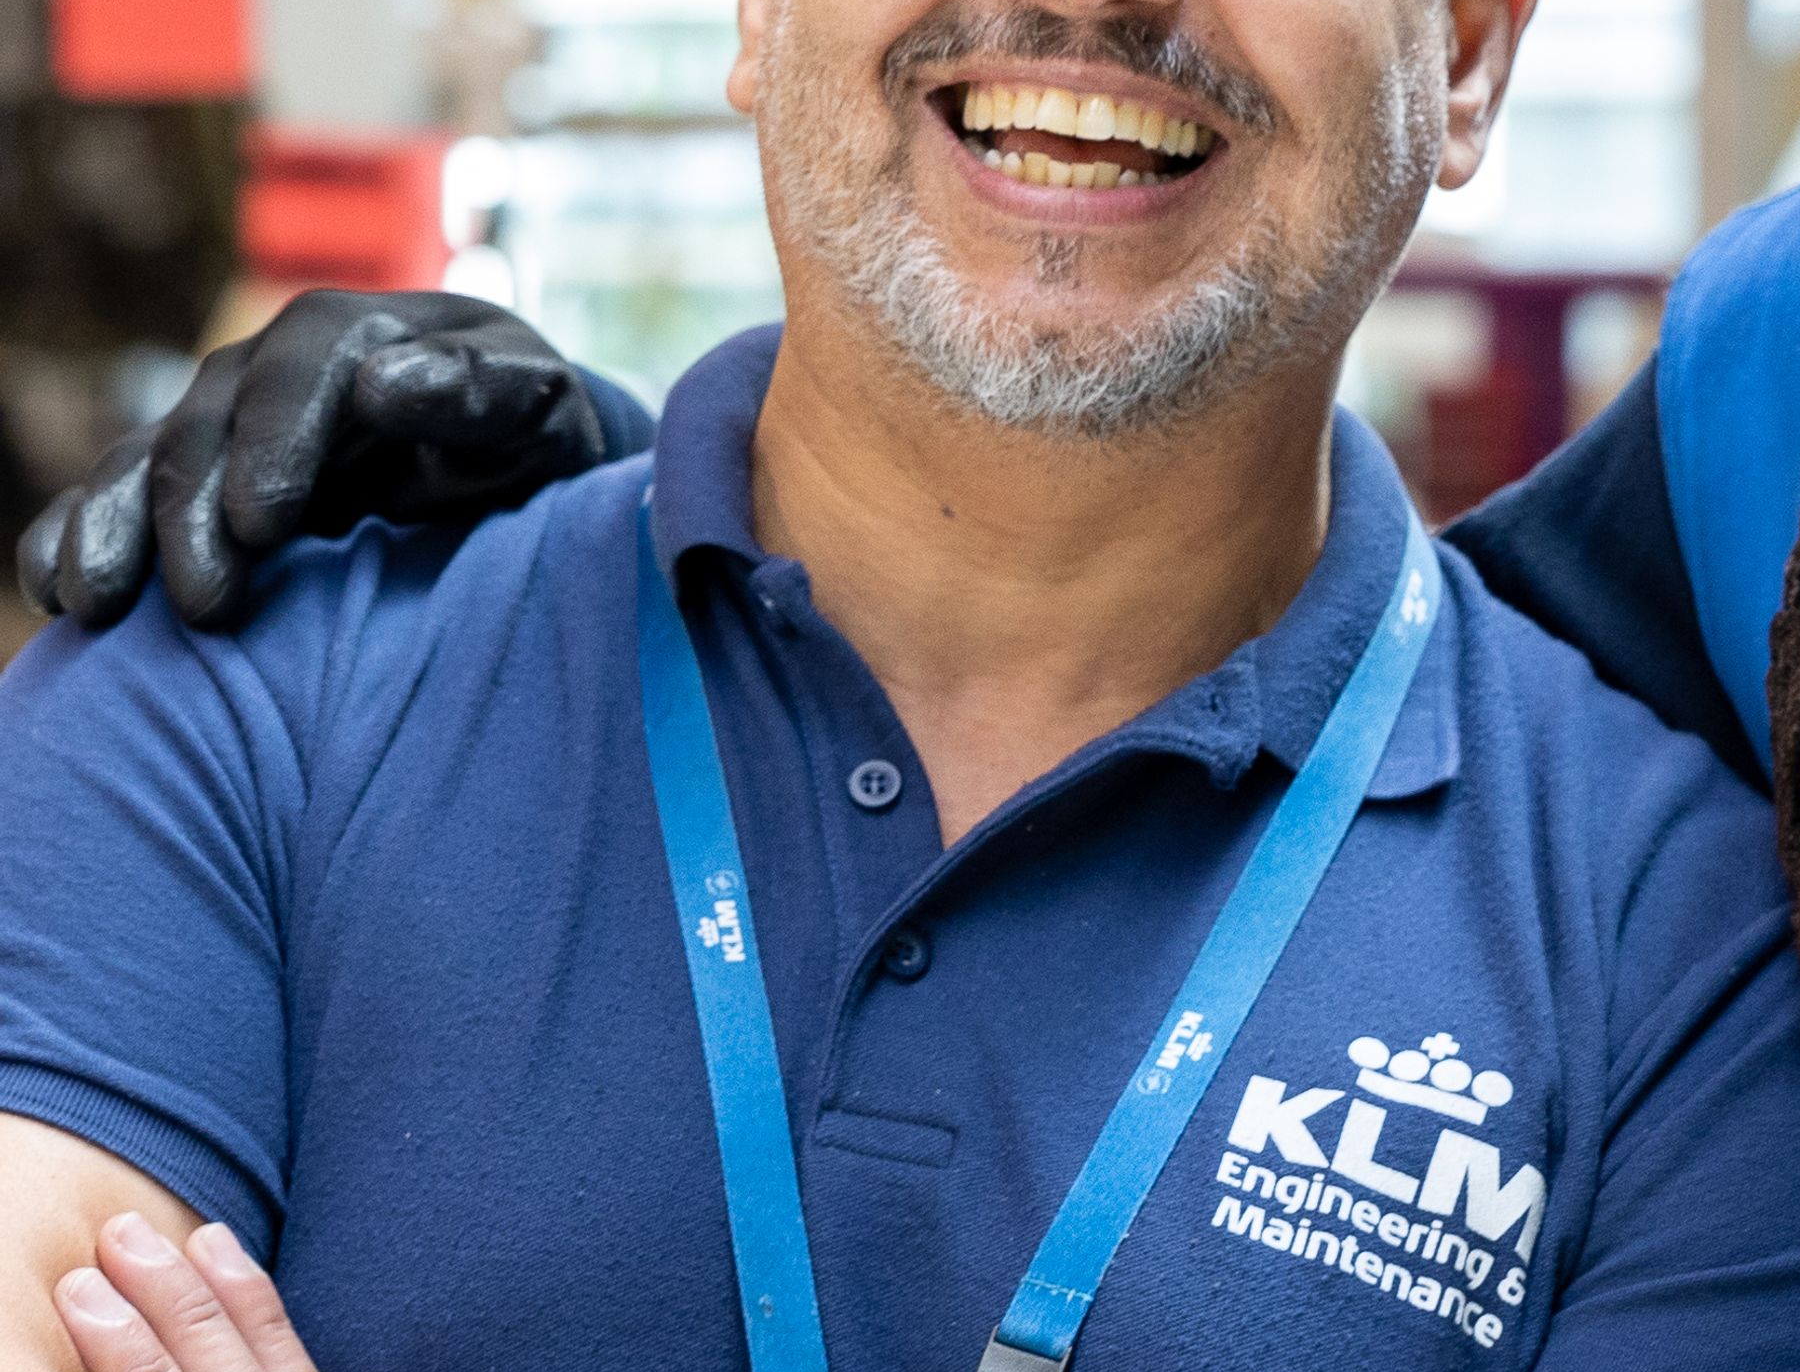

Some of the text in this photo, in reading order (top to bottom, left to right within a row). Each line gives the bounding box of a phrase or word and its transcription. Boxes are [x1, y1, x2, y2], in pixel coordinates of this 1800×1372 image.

[714, 899, 746, 962] KLM
[1155, 1009, 1204, 1070] KLM
[1215, 1151, 1528, 1307] Engineering &
[1227, 1074, 1547, 1266] KLM
[1210, 1195, 1504, 1349] Maintenance
